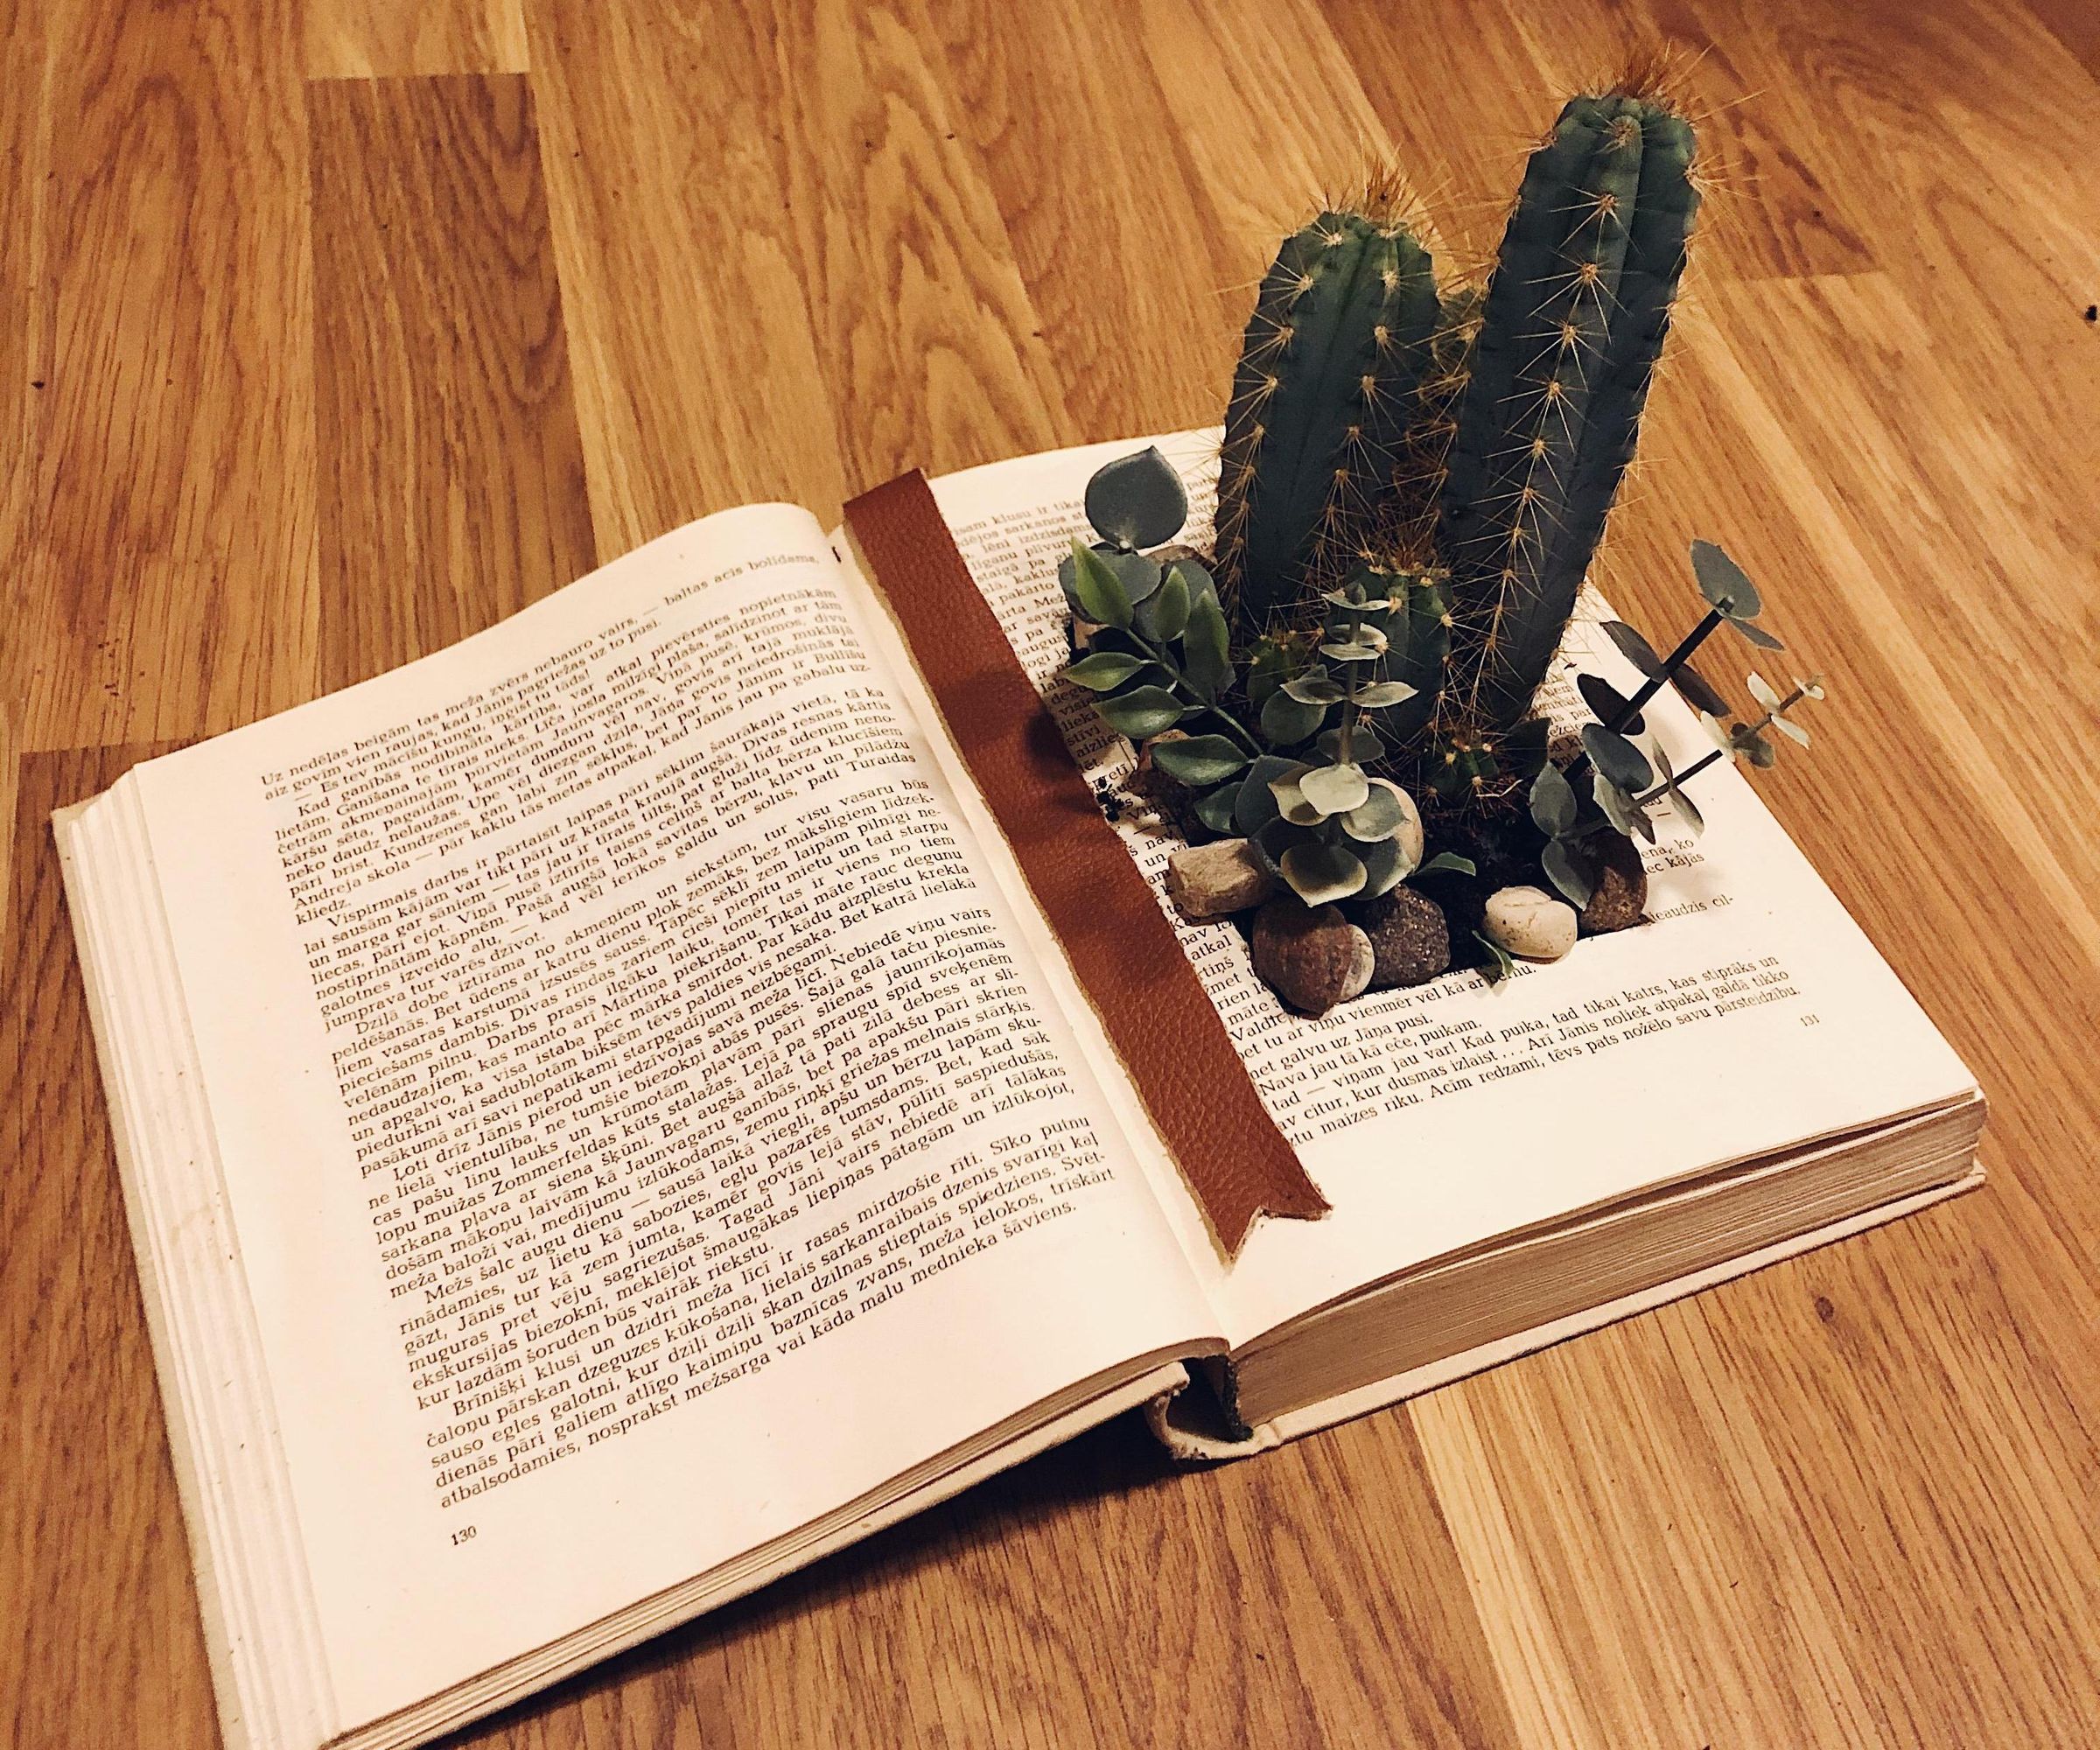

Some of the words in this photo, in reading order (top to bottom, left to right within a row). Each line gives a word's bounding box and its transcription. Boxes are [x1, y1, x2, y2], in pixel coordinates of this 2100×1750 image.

[261, 773, 284, 785] Uz
[290, 749, 348, 776] nedēļas
[354, 724, 410, 751] beigām
[417, 713, 439, 726] tas
[445, 694, 484, 716] meža
[535, 640, 593, 675] nebauro
[265, 786, 289, 801] aiz
[292, 766, 341, 793] govīm
[346, 751, 381, 767] vien
[386, 731, 438, 753] raujas,
[441, 712, 470, 732] kad
[477, 696, 513, 717] Jānis
[517, 659, 585, 700] pagriežas
[590, 648, 605, 661] uz
[609, 639, 625, 650] to
[304, 938, 326, 955] lai
[332, 915, 392, 944] sausām
[397, 892, 449, 918] kājām
[454, 878, 480, 893] var
[487, 862, 514, 880] tikt
[521, 846, 553, 869] pāri
[559, 834, 578, 847] uz
[581, 808, 629, 836] krasta
[634, 778, 685, 809] kraujā
[691, 753, 738, 780] augšā.
[742, 727, 788, 752] Divas
[792, 708, 843, 730] resnas
[1144, 853, 1166, 867] un
[1665, 853, 1704, 867] kājās
[1674, 839, 1694, 850] ko
[296, 899, 351, 925] kliedz.
[1191, 935, 1232, 961] atkal
[1712, 894, 1732, 906] cil-
[326, 992, 406, 1033] jumprava
[410, 979, 434, 995] tur
[440, 960, 486, 982] varēs
[490, 932, 545, 962] dzīvot.
[1227, 1002, 1270, 1026] māte
[1264, 1036, 1284, 1049] tu
[1288, 1027, 1304, 1040] ar
[1307, 1013, 1346, 1033] viņu
[1348, 997, 1412, 1021] vienmēr
[1415, 987, 1442, 1004] vēl
[1444, 982, 1466, 998] kā
[1468, 977, 1485, 990] ar
[1800, 1014, 1820, 1026] 131
[360, 1130, 449, 1180] pasākumā
[454, 1117, 478, 1138] arī
[483, 1101, 518, 1125] savi
[522, 1055, 618, 1108] nepatīkami
[623, 995, 737, 1061] starpgadījumi
[740, 943, 836, 1001] neizbēgami.
[393, 1157, 429, 1181] Ļoti
[436, 1143, 471, 1163] drīz
[477, 1120, 522, 1146] Jānis
[528, 1088, 583, 1128] pierod
[589, 1080, 612, 1095] un
[618, 1034, 702, 1083] iedzīvojas
[707, 1011, 745, 1039] savā
[749, 987, 791, 1016] meža
[794, 967, 827, 990] līcī.
[830, 930, 901, 970] Nebiedē
[906, 917, 946, 934] viņu
[951, 907, 991, 922] vairs
[1259, 1072, 1307, 1096] Nava
[1310, 1060, 1339, 1080] jau
[1340, 1052, 1359, 1065] tā
[1362, 1045, 1382, 1060] kā
[1385, 1037, 1418, 1053] eče,
[1418, 1020, 1482, 1046] puikam.
[1272, 1090, 1301, 1111] tad
[1333, 1065, 1385, 1088] viņam
[1391, 1054, 1419, 1073] jau
[1424, 1041, 1458, 1059] var!
[1461, 1031, 1496, 1050] Kad
[1500, 1020, 1550, 1042] puika,
[1552, 1007, 1579, 1024] tad
[1583, 998, 1620, 1013] tikai
[1621, 985, 1668, 1003] katrs,
[1668, 976, 1698, 990] kas
[1759, 956, 1779, 968] un
[1280, 1044, 1327, 1070] galvu
[1330, 1036, 1351, 1049] uz
[1354, 1025, 1393, 1042] Jāņa
[1304, 1097, 1349, 1119] citur,
[1351, 1085, 1382, 1102] kur
[1388, 1066, 1448, 1090] dusmas
[1449, 1050, 1498, 1072] izlaist
[1529, 1033, 1554, 1051] Arī
[1558, 1022, 1599, 1041] Jānis
[1602, 1005, 1651, 1027] noliek
[1655, 988, 1710, 1012] atpakaļ
[1752, 970, 1788, 988] tikko
[1320, 1107, 1378, 1134] maizes
[1384, 1094, 1424, 1112] riku.
[1431, 1078, 1473, 1098] Acīm
[1478, 1055, 1545, 1083] redzami,
[1547, 1046, 1582, 1062] tēvs
[1586, 1035, 1619, 1054] pats
[1622, 1018, 1672, 1040] nožēlo
[1676, 1008, 1712, 1025] savu
[416, 1388, 450, 1410] kur
[455, 1359, 522, 1394] lazdām
[527, 1324, 600, 1364] šoruden
[604, 1306, 637, 1327] būs
[641, 1276, 702, 1309] vairāk
[707, 1242, 774, 1281] riekstu.
[427, 1414, 490, 1447] čaloņu
[496, 1380, 571, 1424] pārskan
[578, 1338, 661, 1383] dzeguzes
[664, 1295, 757, 1343] kūkošana,
[761, 1262, 816, 1297] lielais
[821, 1196, 937, 1266] sarkanraibais
[942, 1167, 998, 1200] dzenis
[1070, 1131, 1099, 1149] kaļ
[436, 1454, 498, 1488] dienās
[506, 1431, 545, 1462] pāri
[554, 1403, 617, 1441] galiem
[626, 1374, 679, 1405] atlīgo
[685, 1334, 763, 1377] kaimiņu
[770, 1289, 848, 1335] baznīcas
[857, 1256, 912, 1292] zvans,
[918, 1228, 965, 1257] meža
[972, 1194, 1043, 1229] ielokos,
[441, 1442, 580, 1508] atbalsodamies,
[587, 1394, 678, 1446] nosprakst
[684, 1353, 771, 1401] mežsarga
[776, 1332, 806, 1354] vai
[809, 1310, 855, 1340] kāda
[860, 1281, 904, 1313] malu
[910, 1235, 998, 1284] mednieka
[1003, 1202, 1076, 1238] šāviens.
[452, 1526, 477, 1545] 130
